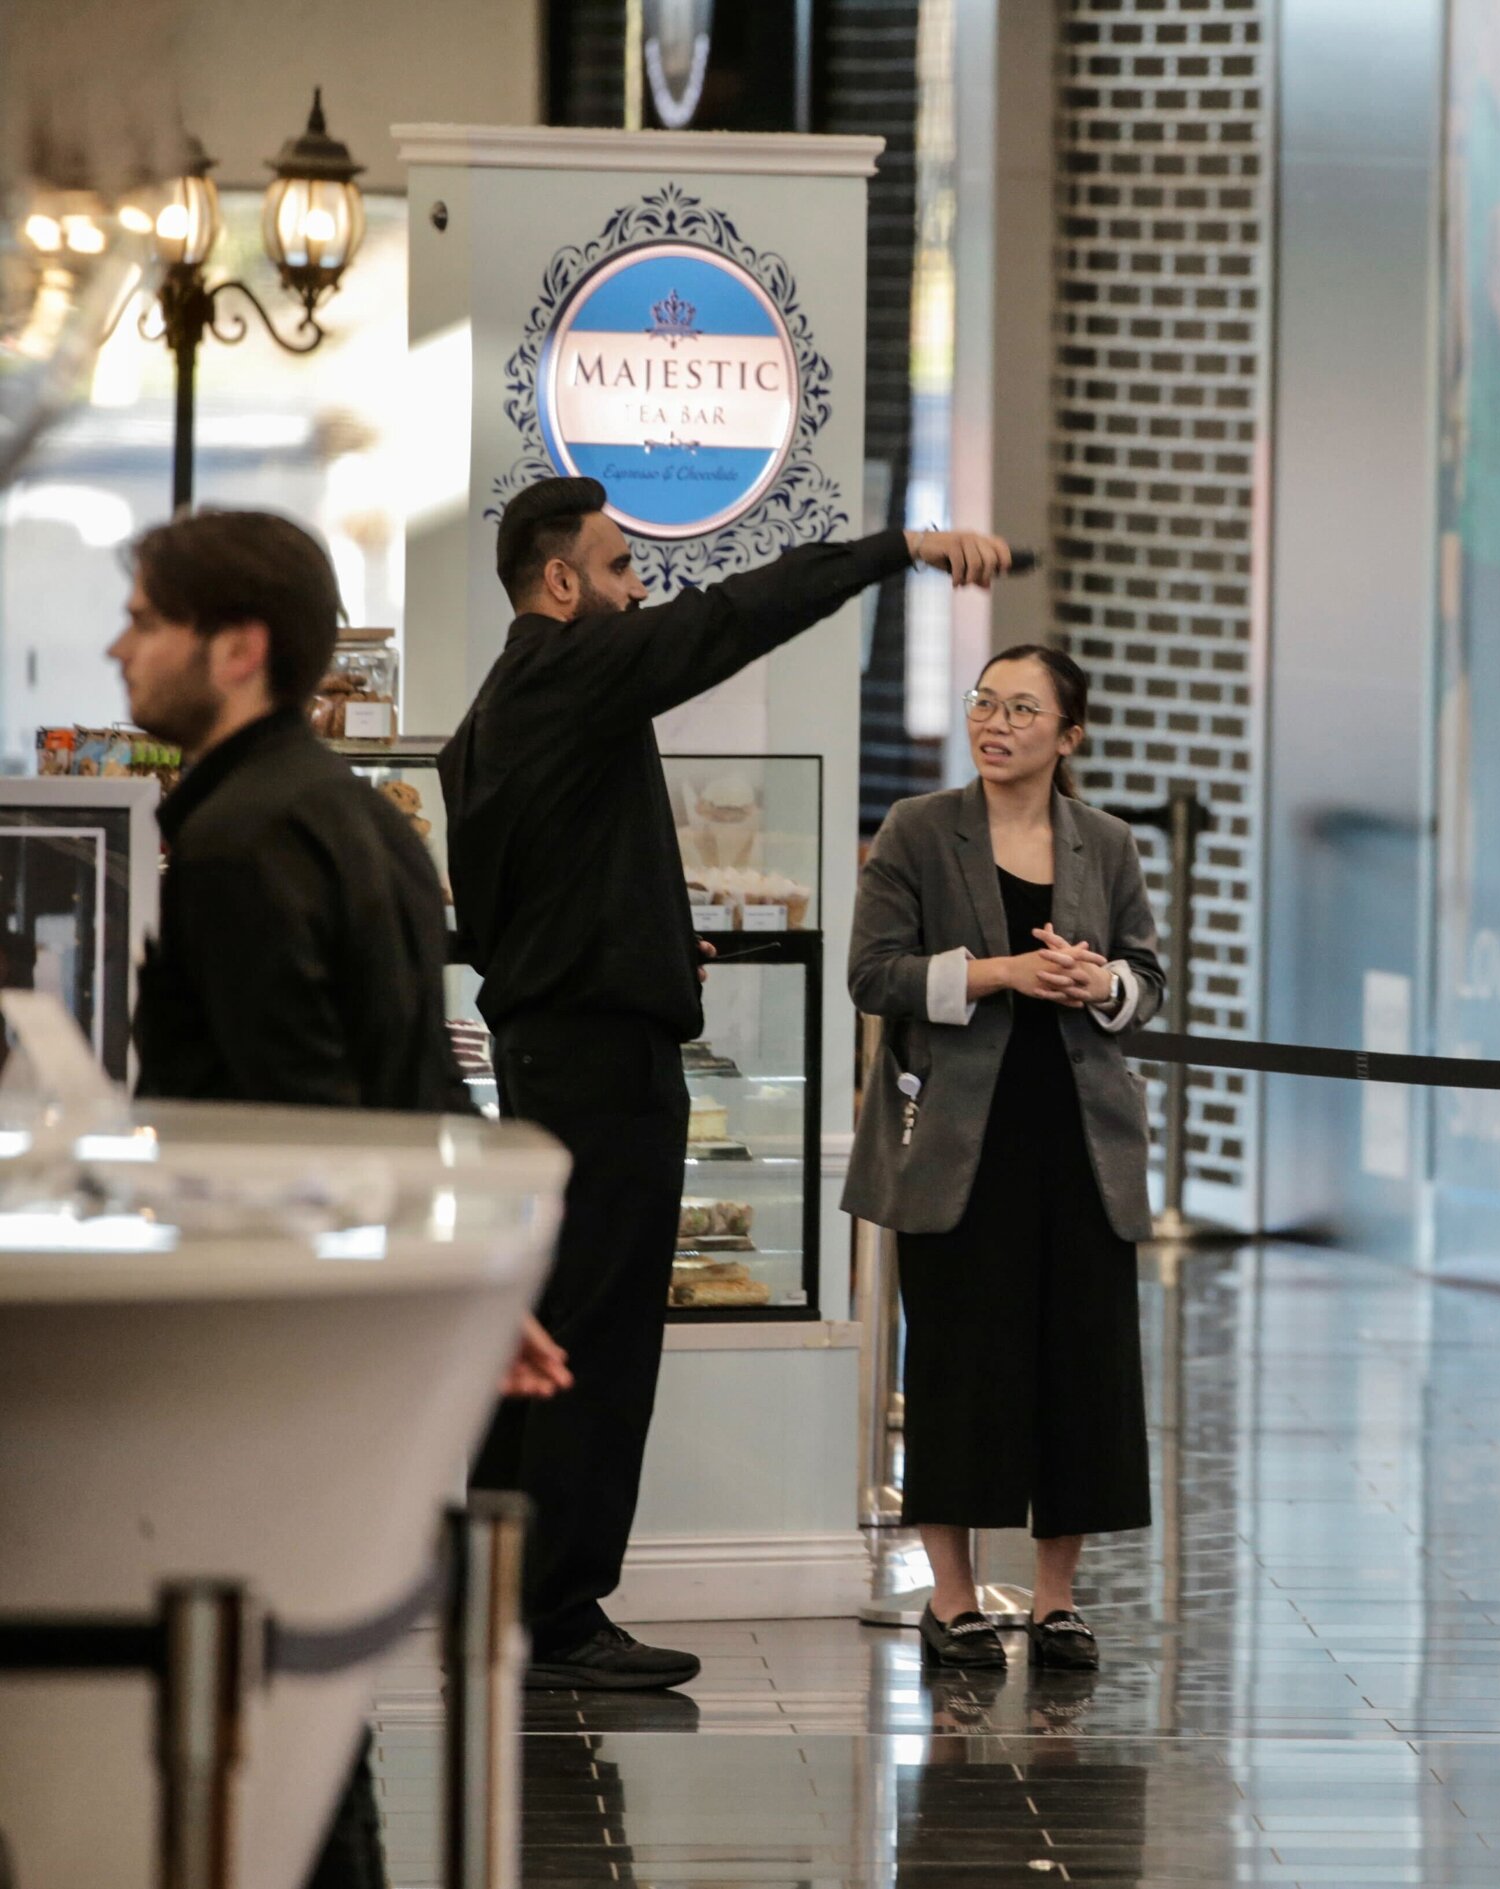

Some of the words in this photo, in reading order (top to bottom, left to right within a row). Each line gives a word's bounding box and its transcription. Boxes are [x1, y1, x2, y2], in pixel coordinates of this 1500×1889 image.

[573, 352, 780, 393] MAJESTIC
[624, 403, 667, 424] TEA
[680, 405, 726, 425] BAR
[602, 463, 659, 481] Espresso
[676, 466, 739, 482] Chocolate
